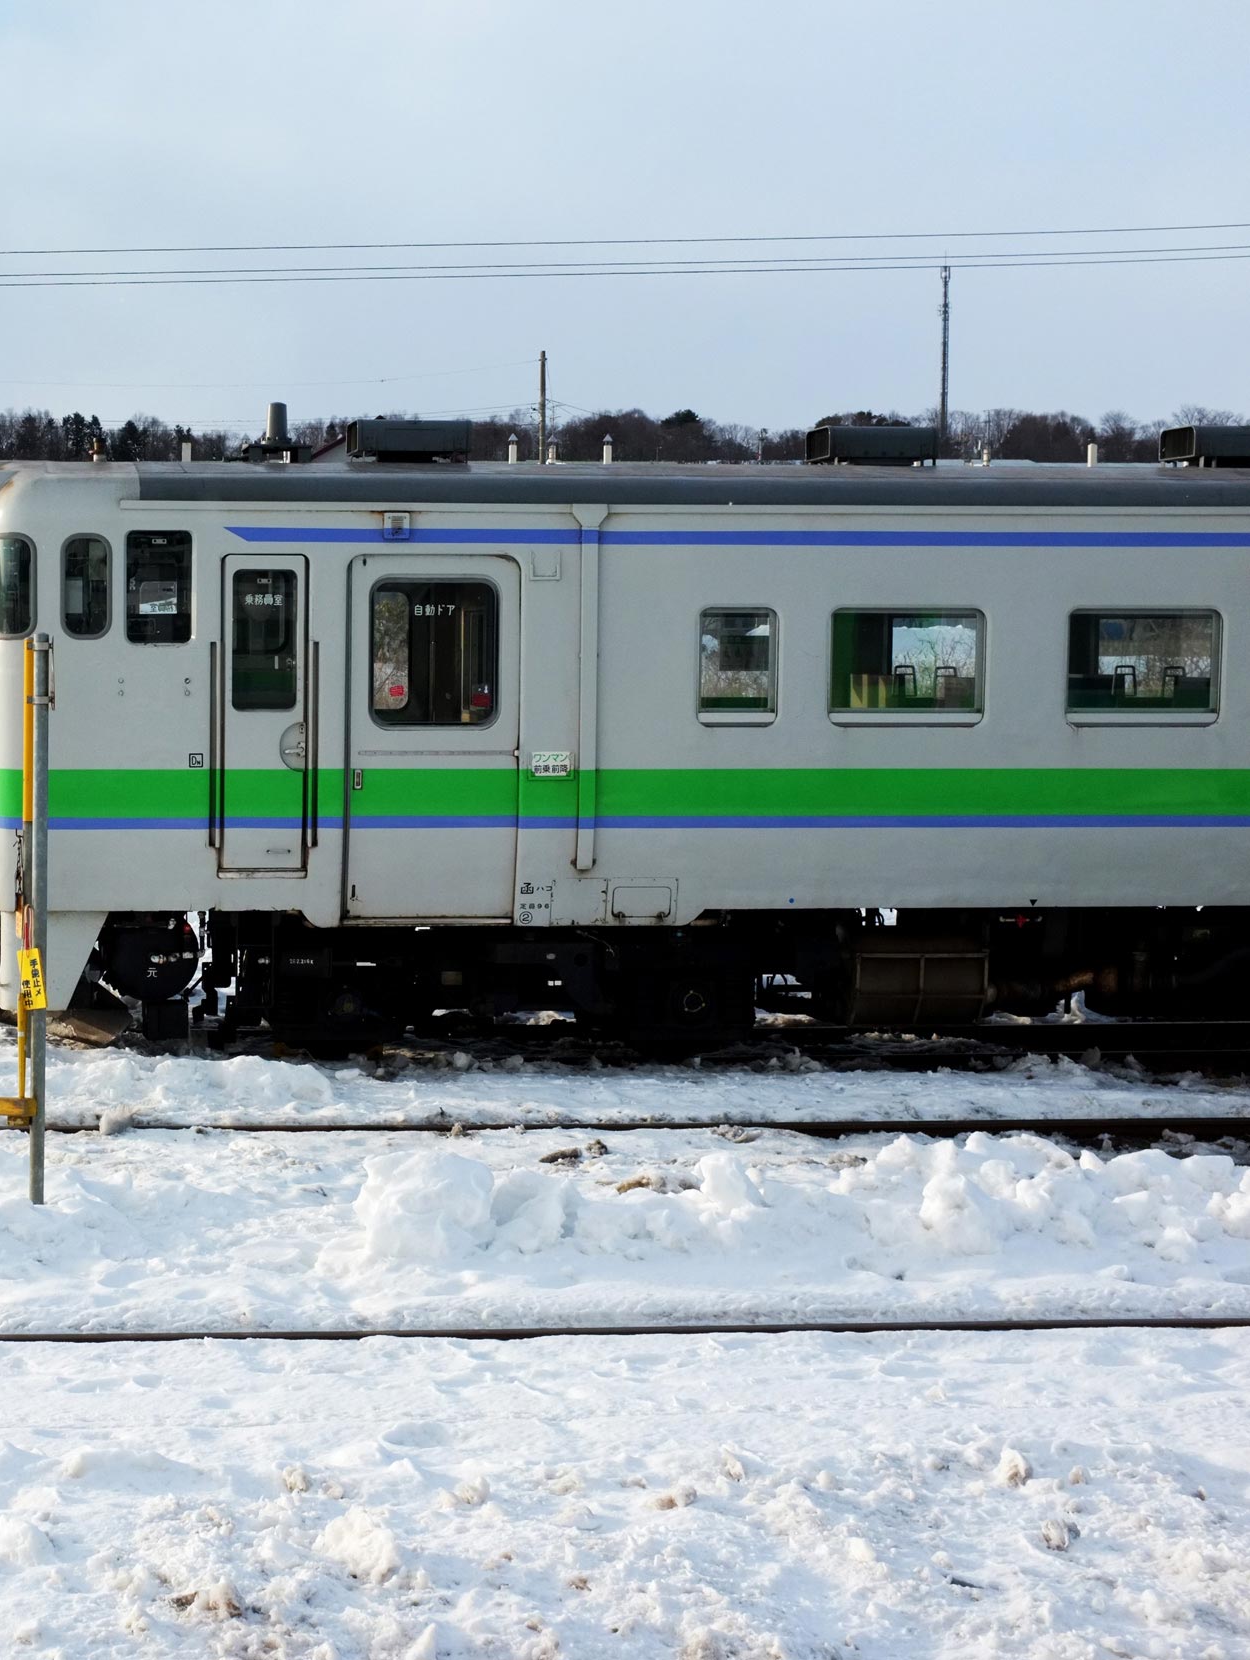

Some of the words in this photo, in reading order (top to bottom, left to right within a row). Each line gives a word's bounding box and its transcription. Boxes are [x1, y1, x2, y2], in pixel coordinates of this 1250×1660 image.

[245, 593, 283, 606] 乗務員室
[414, 604, 455, 616] 自動ドア
[533, 753, 568, 763] ワンマン
[533, 764, 568, 774] 前乗前降
[146, 967, 158, 978] 元
[21, 979, 34, 1008] 使用中
